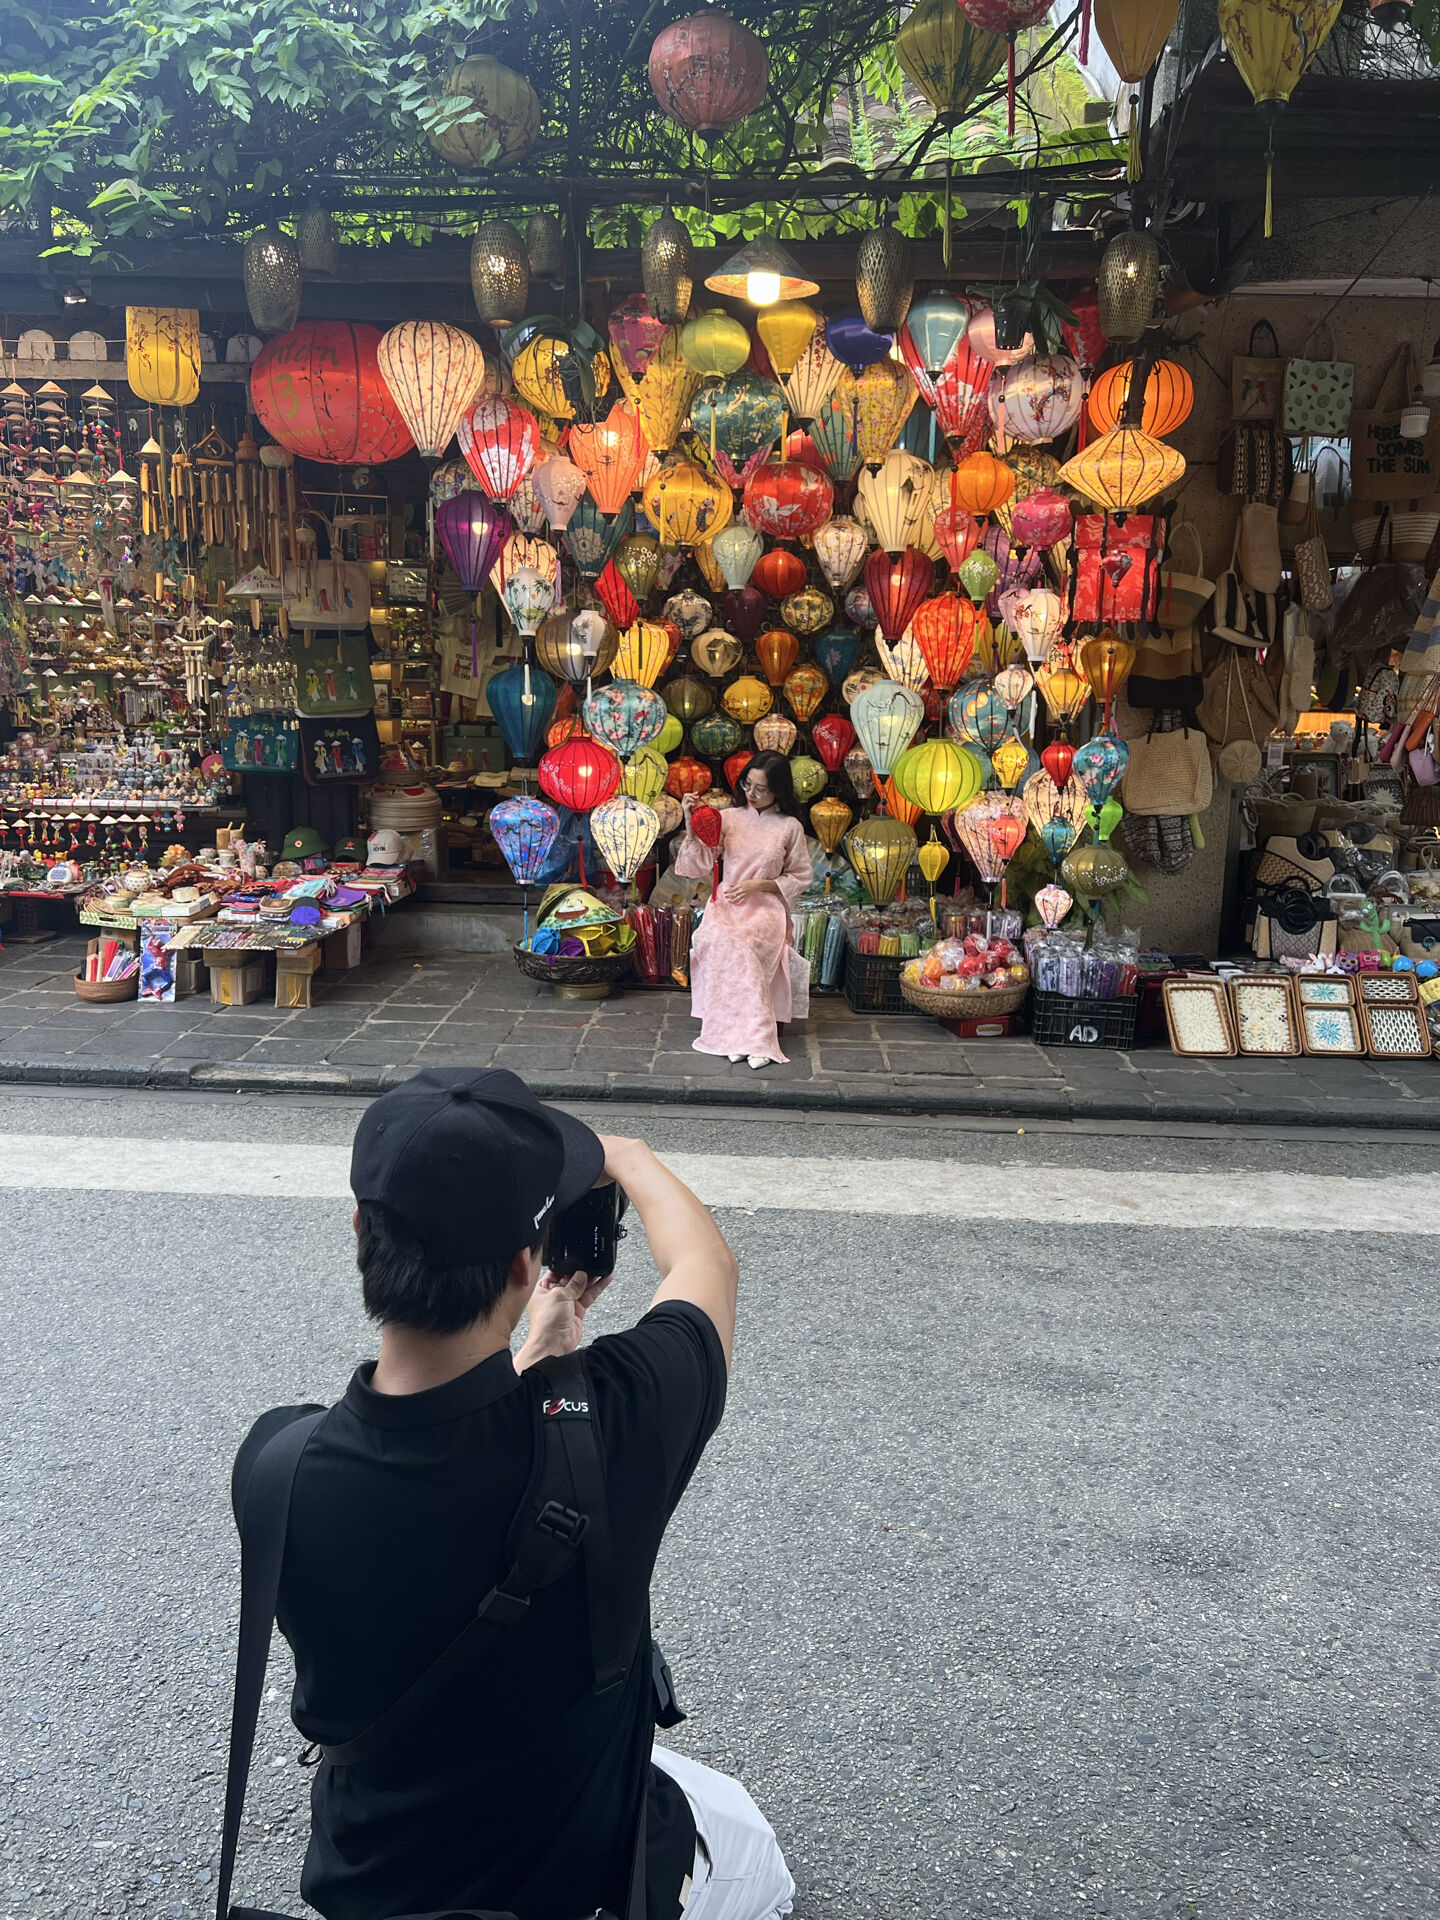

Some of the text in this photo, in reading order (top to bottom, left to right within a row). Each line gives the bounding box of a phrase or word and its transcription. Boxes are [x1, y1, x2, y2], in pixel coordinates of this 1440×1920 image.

[1367, 424, 1400, 441] HERE
[1376, 440, 1425, 457] COMES
[1366, 456, 1431, 474] THE SUN
[1069, 1024, 1099, 1043] AD
